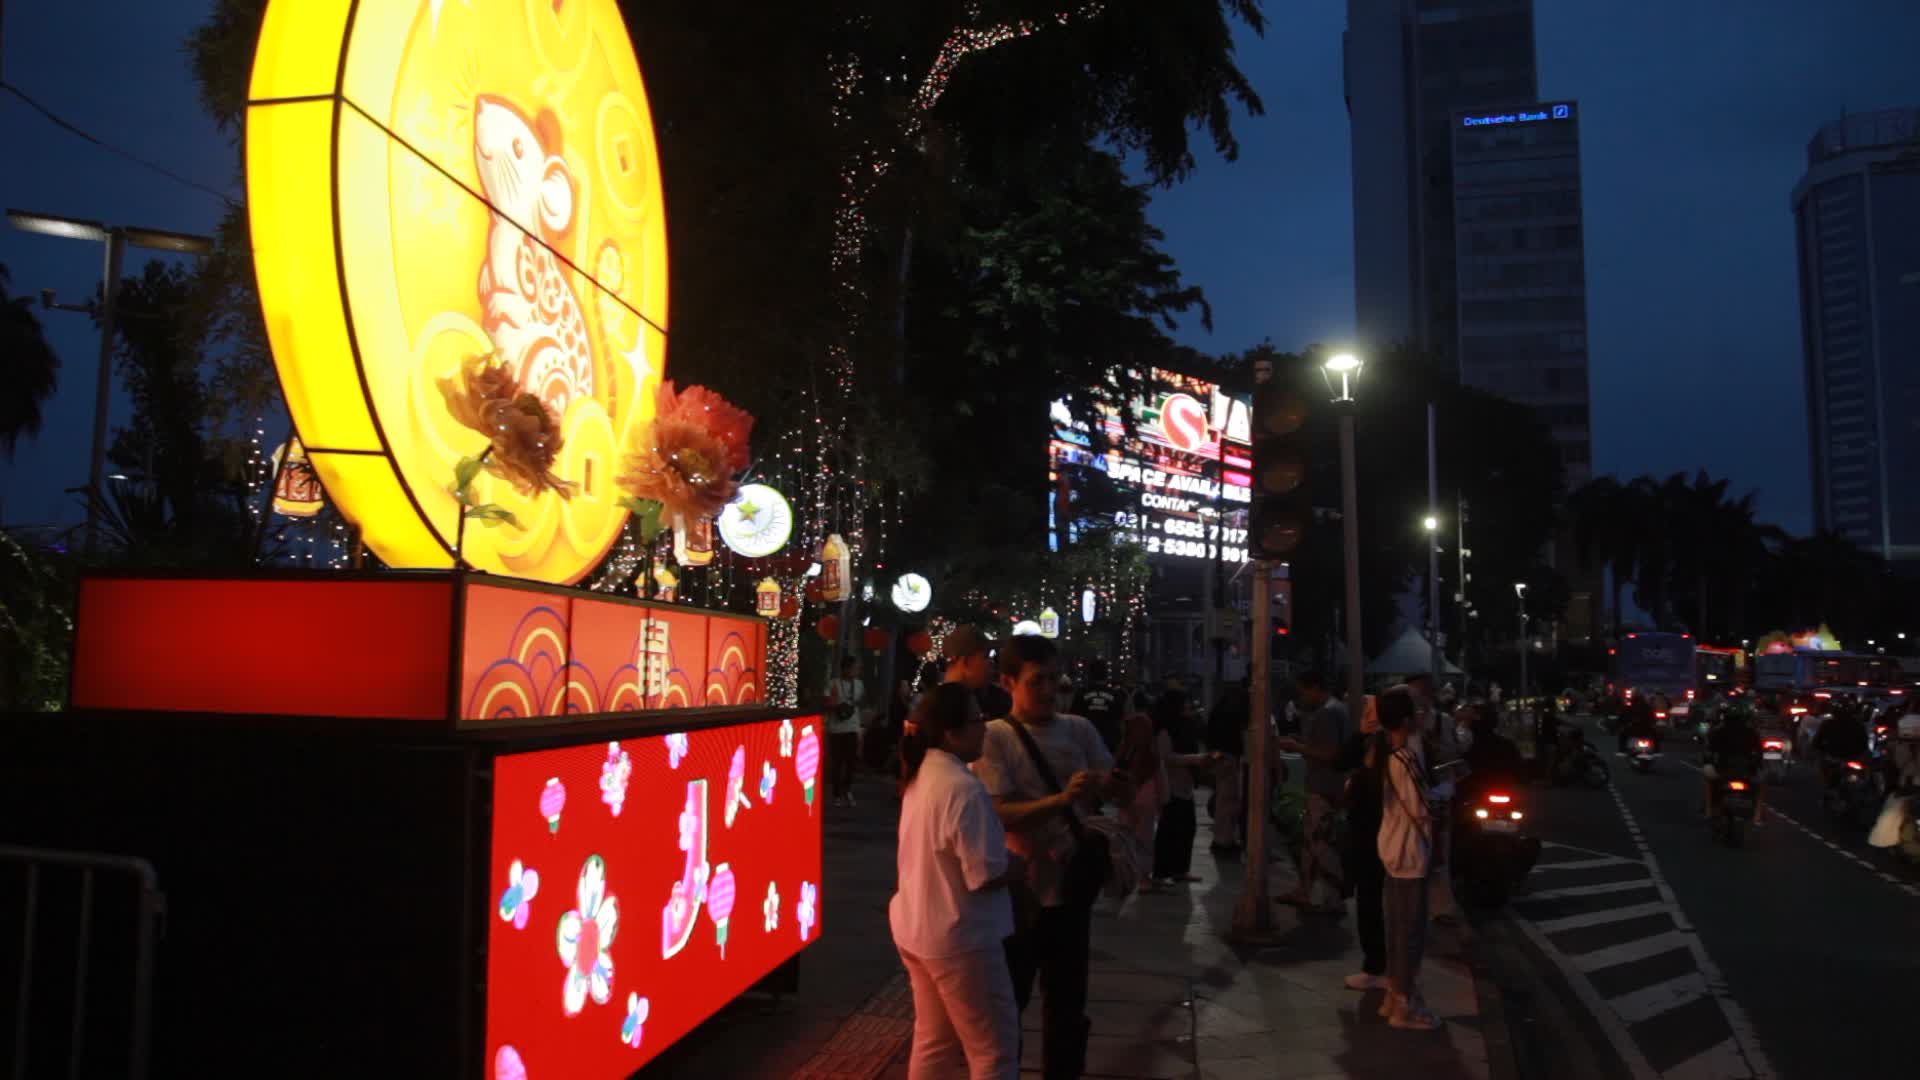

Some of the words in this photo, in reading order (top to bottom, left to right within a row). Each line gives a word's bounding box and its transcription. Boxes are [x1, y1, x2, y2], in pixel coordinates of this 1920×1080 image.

[1464, 115, 1515, 126] Deutsche
[1519, 112, 1548, 121] Bank
[1107, 462, 1166, 487] SPACE
